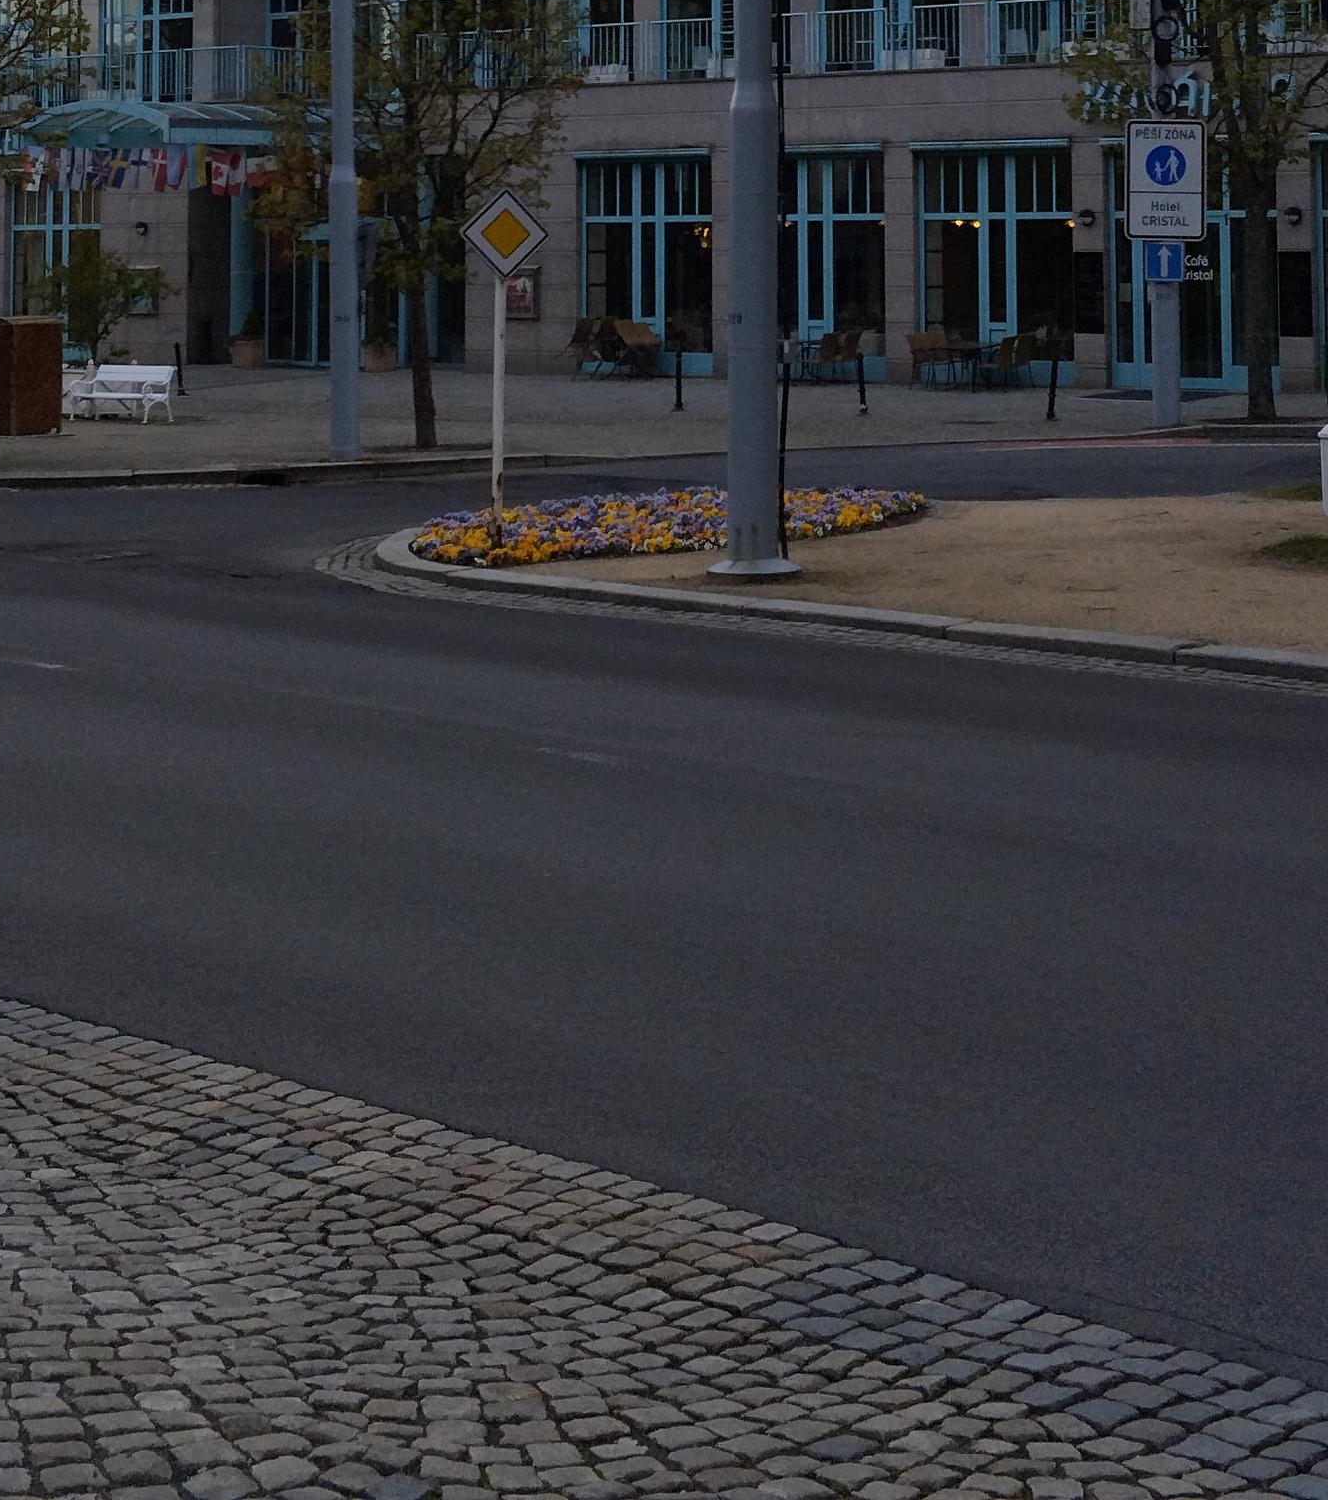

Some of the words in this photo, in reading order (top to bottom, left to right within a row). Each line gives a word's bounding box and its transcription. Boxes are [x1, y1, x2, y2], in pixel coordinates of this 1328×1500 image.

[1135, 127, 1161, 140] PĚŠÍ
[1164, 127, 1196, 140] ZÓNA
[1150, 200, 1180, 212] Hotel
[1141, 215, 1190, 227] CRISTAL
[1184, 254, 1209, 267] Café
[1184, 269, 1214, 281] ristal
